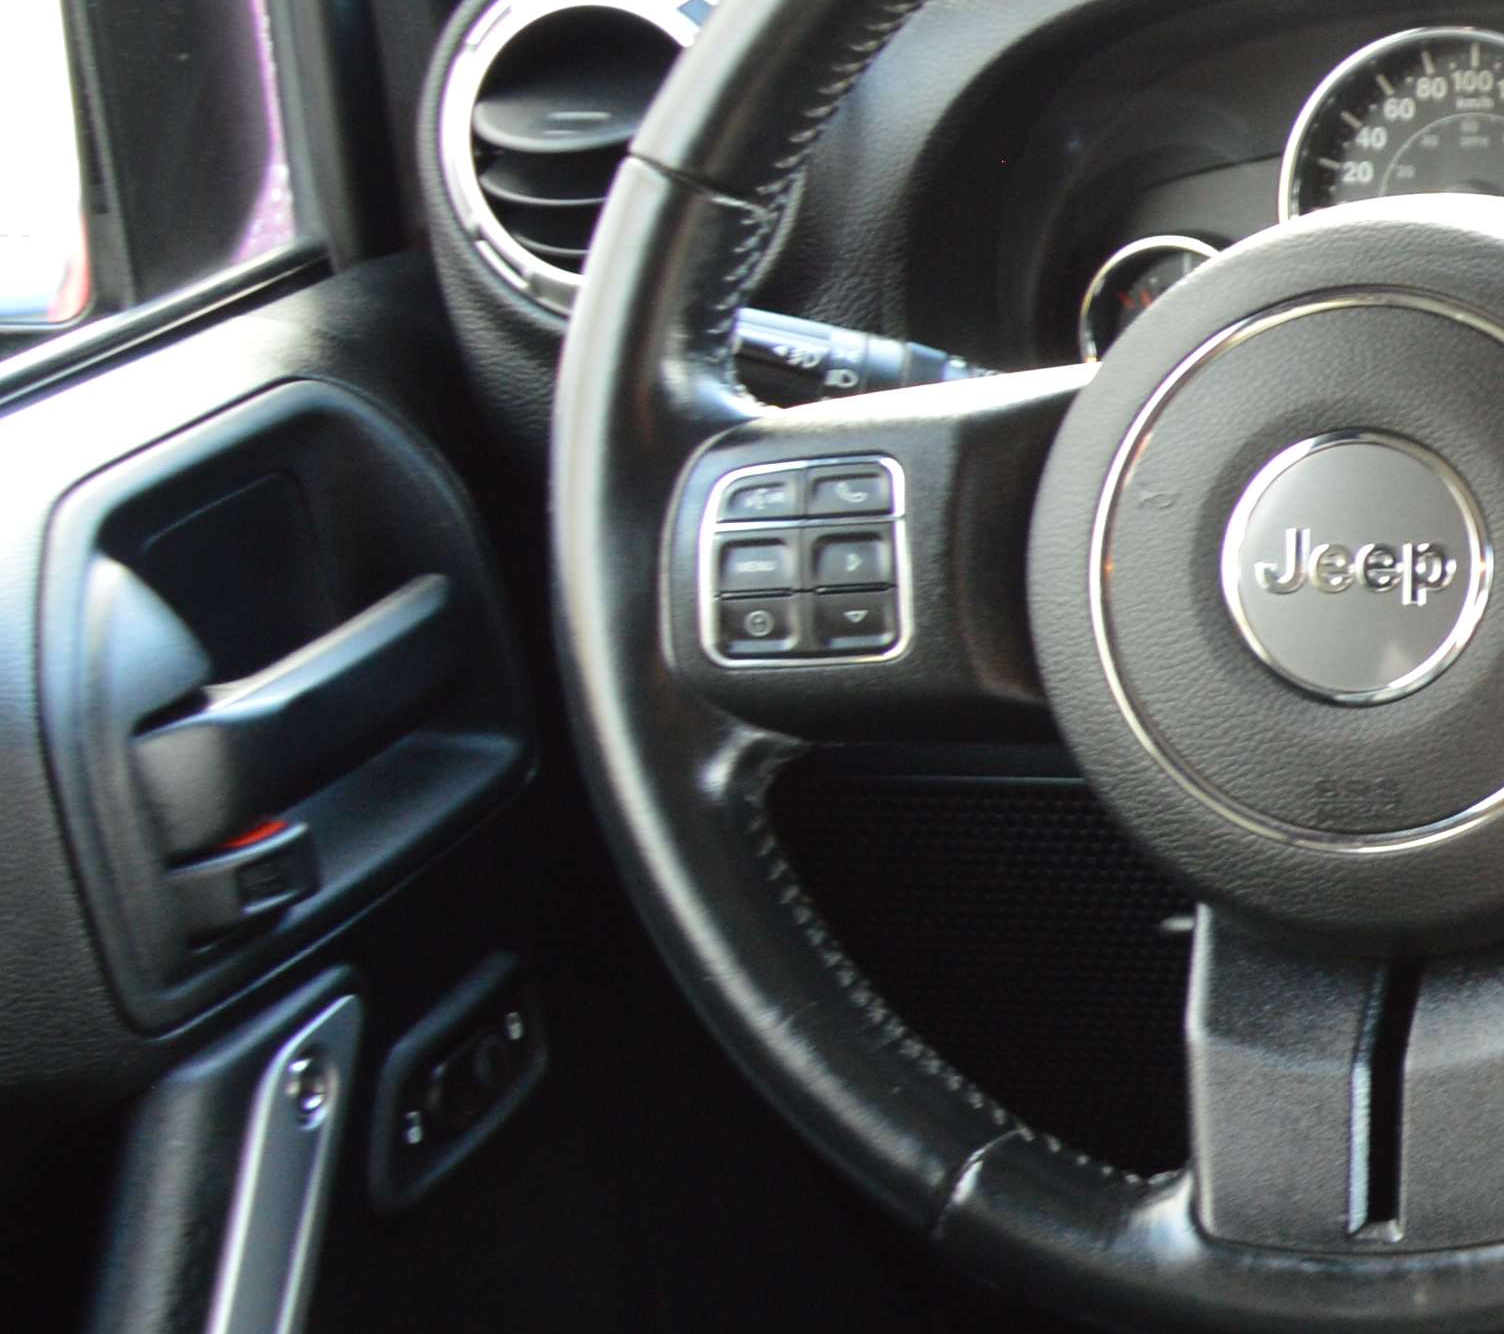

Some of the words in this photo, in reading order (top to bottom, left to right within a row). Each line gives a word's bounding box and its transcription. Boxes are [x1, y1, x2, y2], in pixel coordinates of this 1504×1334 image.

[1416, 77, 1446, 98] 80
[1452, 70, 1493, 92] 100
[1384, 99, 1415, 119] 60
[1356, 128, 1386, 148] 40
[1343, 162, 1373, 182] 20
[1254, 528, 1456, 606] Jeep
